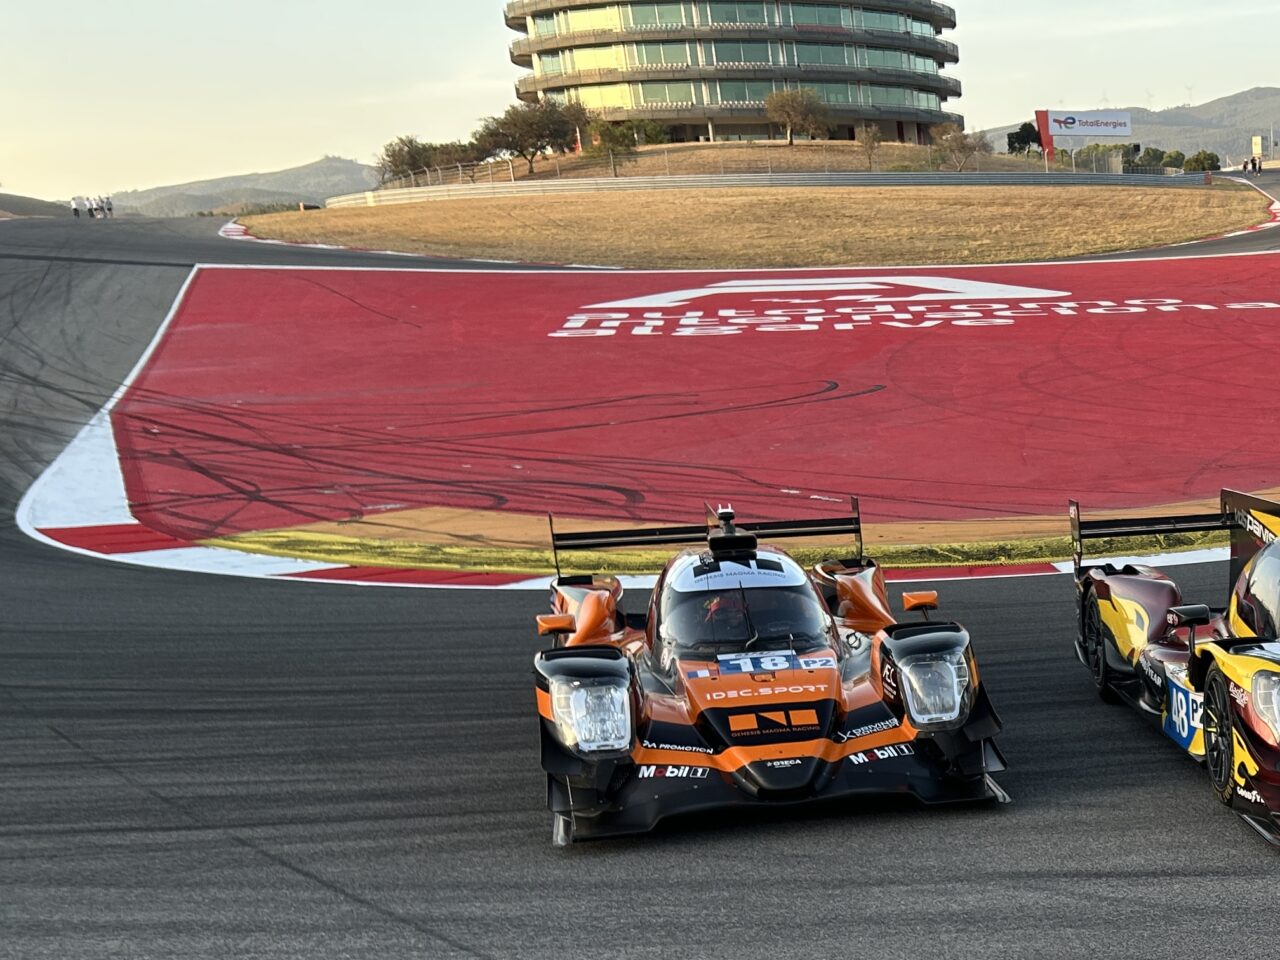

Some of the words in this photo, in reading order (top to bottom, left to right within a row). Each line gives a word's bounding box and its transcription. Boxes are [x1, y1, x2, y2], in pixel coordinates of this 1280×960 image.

[1078, 119, 1127, 129] TotalEnergies
[725, 570, 756, 579] MAGMA
[757, 571, 787, 579] RACING
[729, 656, 790, 673] 18
[803, 658, 834, 668] P2
[706, 684, 829, 701] IDEC.SPORT
[1172, 687, 1189, 738] 48
[731, 730, 760, 738] GENESIS
[659, 743, 714, 754] PROMOTION
[848, 745, 898, 765] Mobil
[638, 765, 690, 779] Mobil
